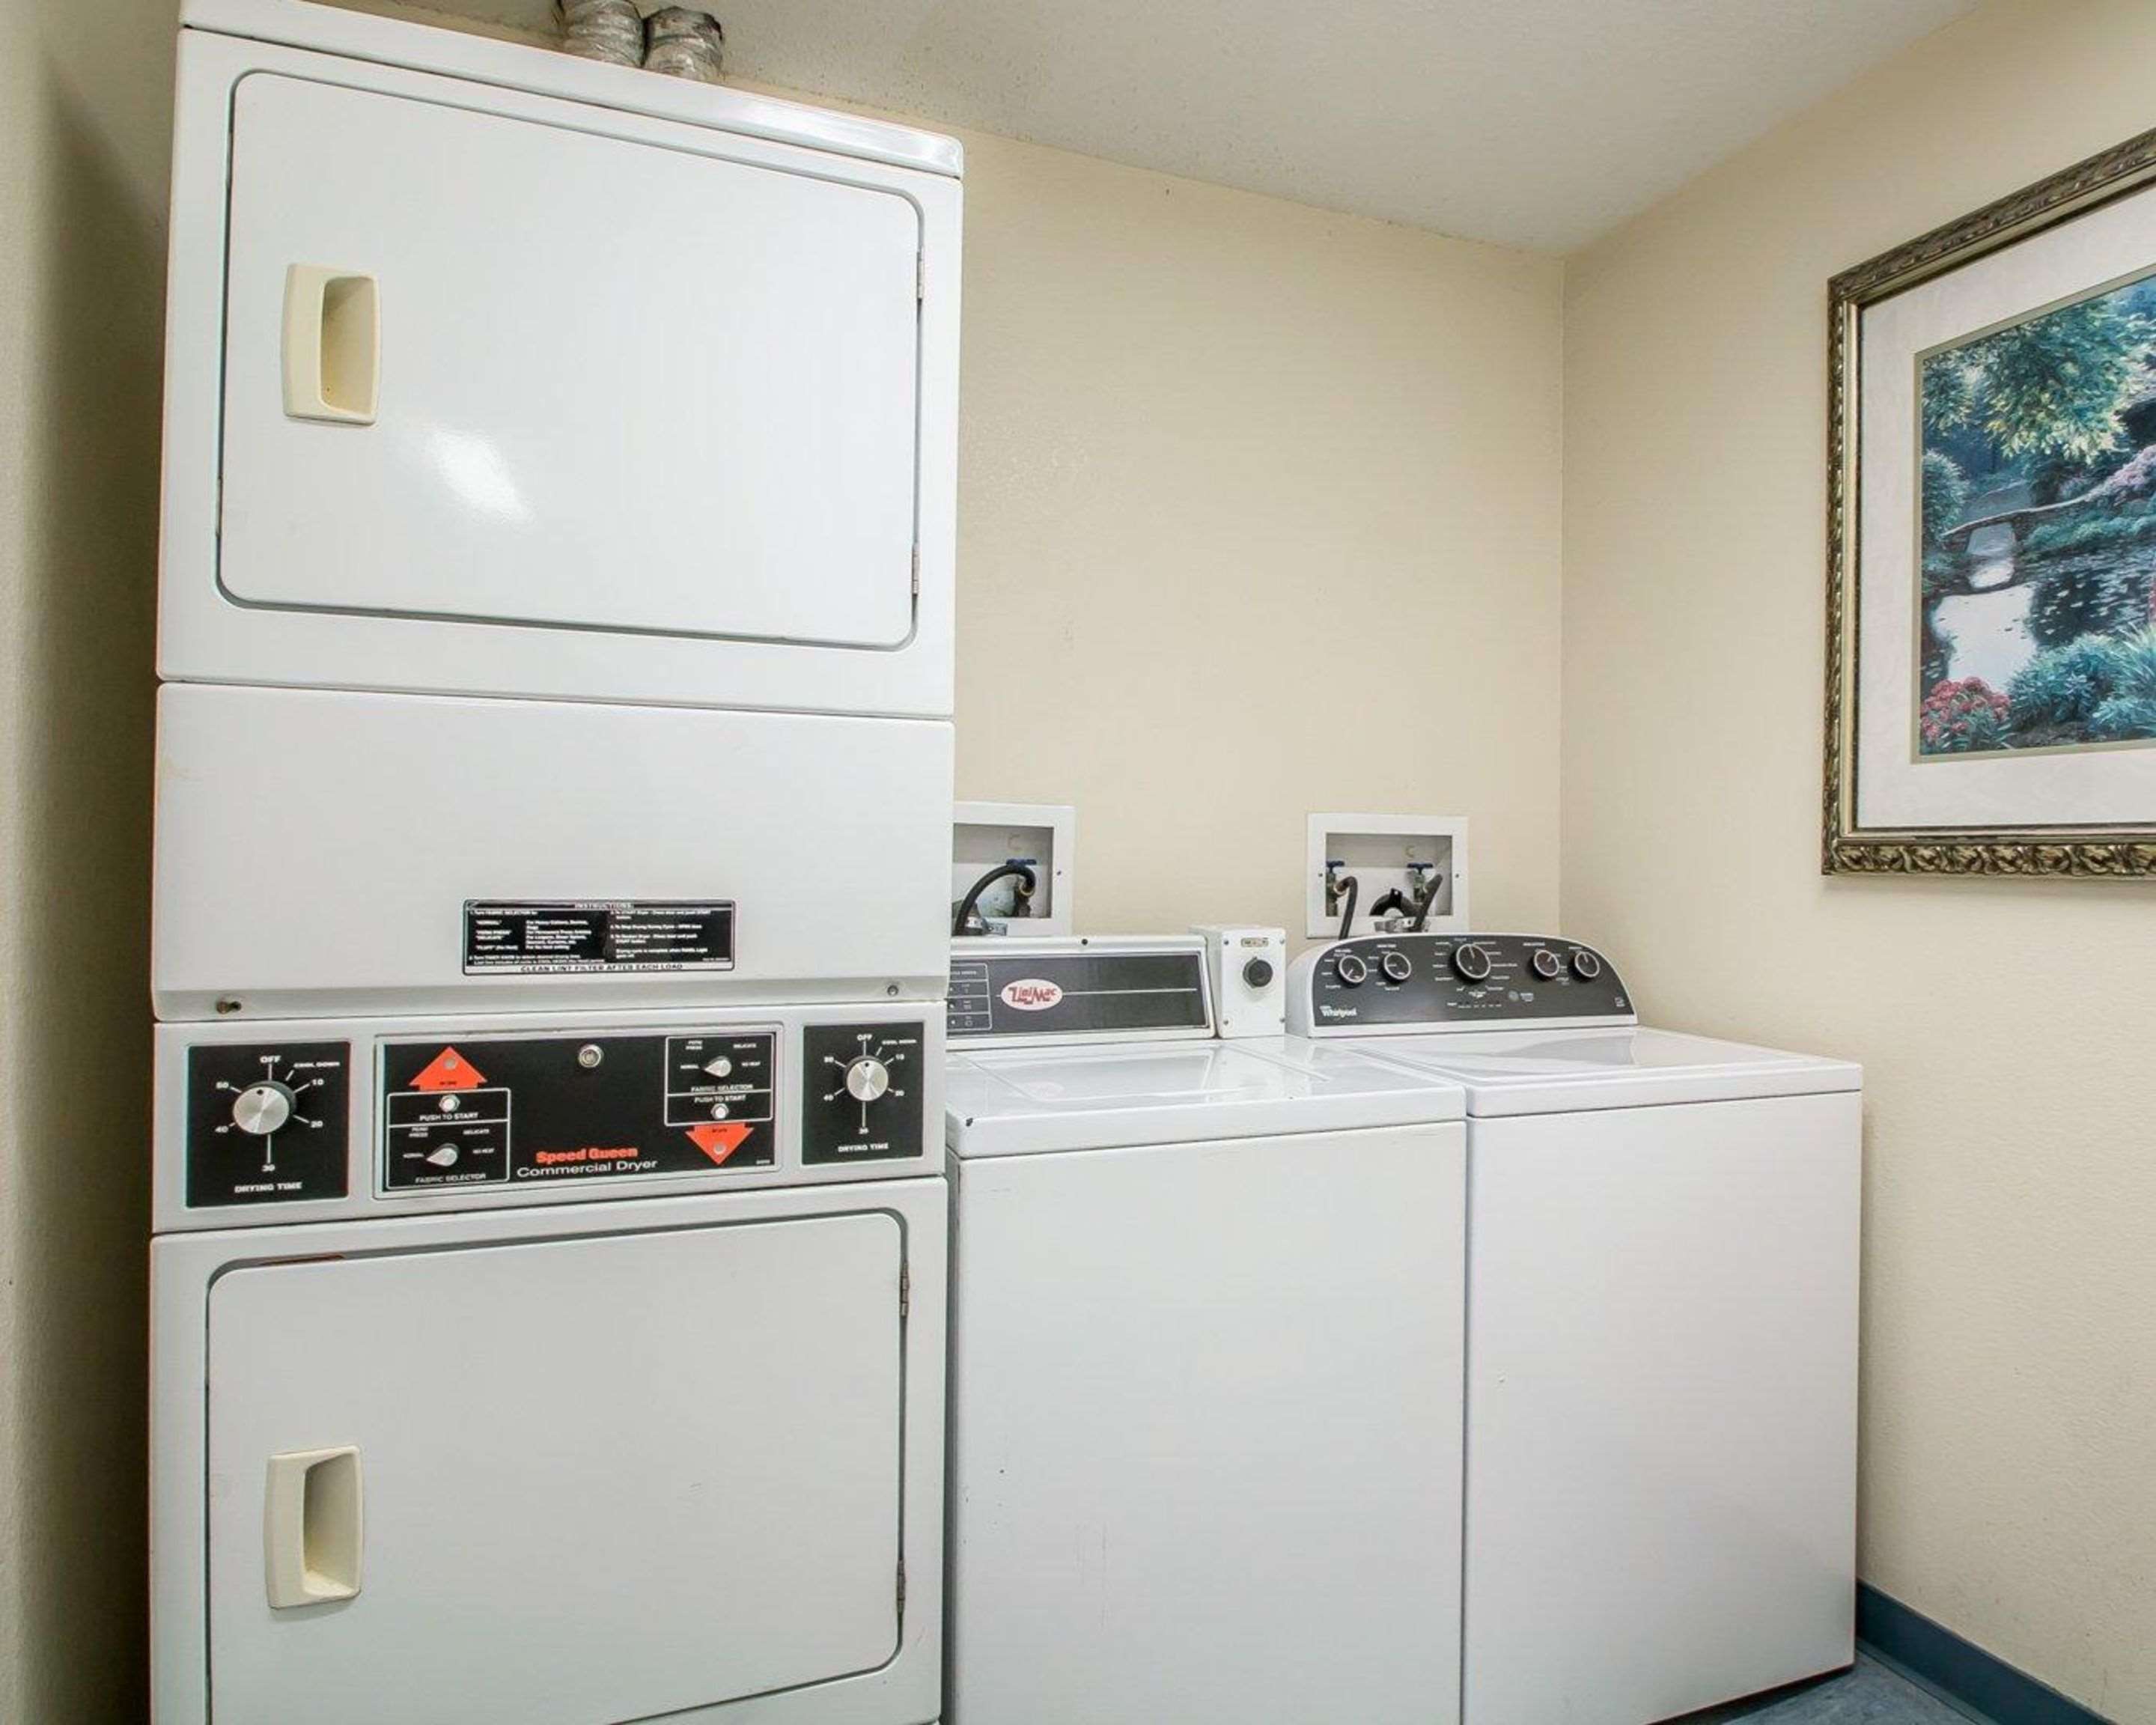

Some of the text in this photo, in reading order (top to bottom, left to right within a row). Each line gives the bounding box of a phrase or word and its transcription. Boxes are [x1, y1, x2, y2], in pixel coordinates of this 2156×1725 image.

[260, 1055, 281, 1063] OFF
[454, 1112, 478, 1120] START
[536, 1146, 639, 1165] Speed Queen
[517, 1160, 659, 1178] Commercial Dryer
[234, 1181, 302, 1193] DRYING TIME
